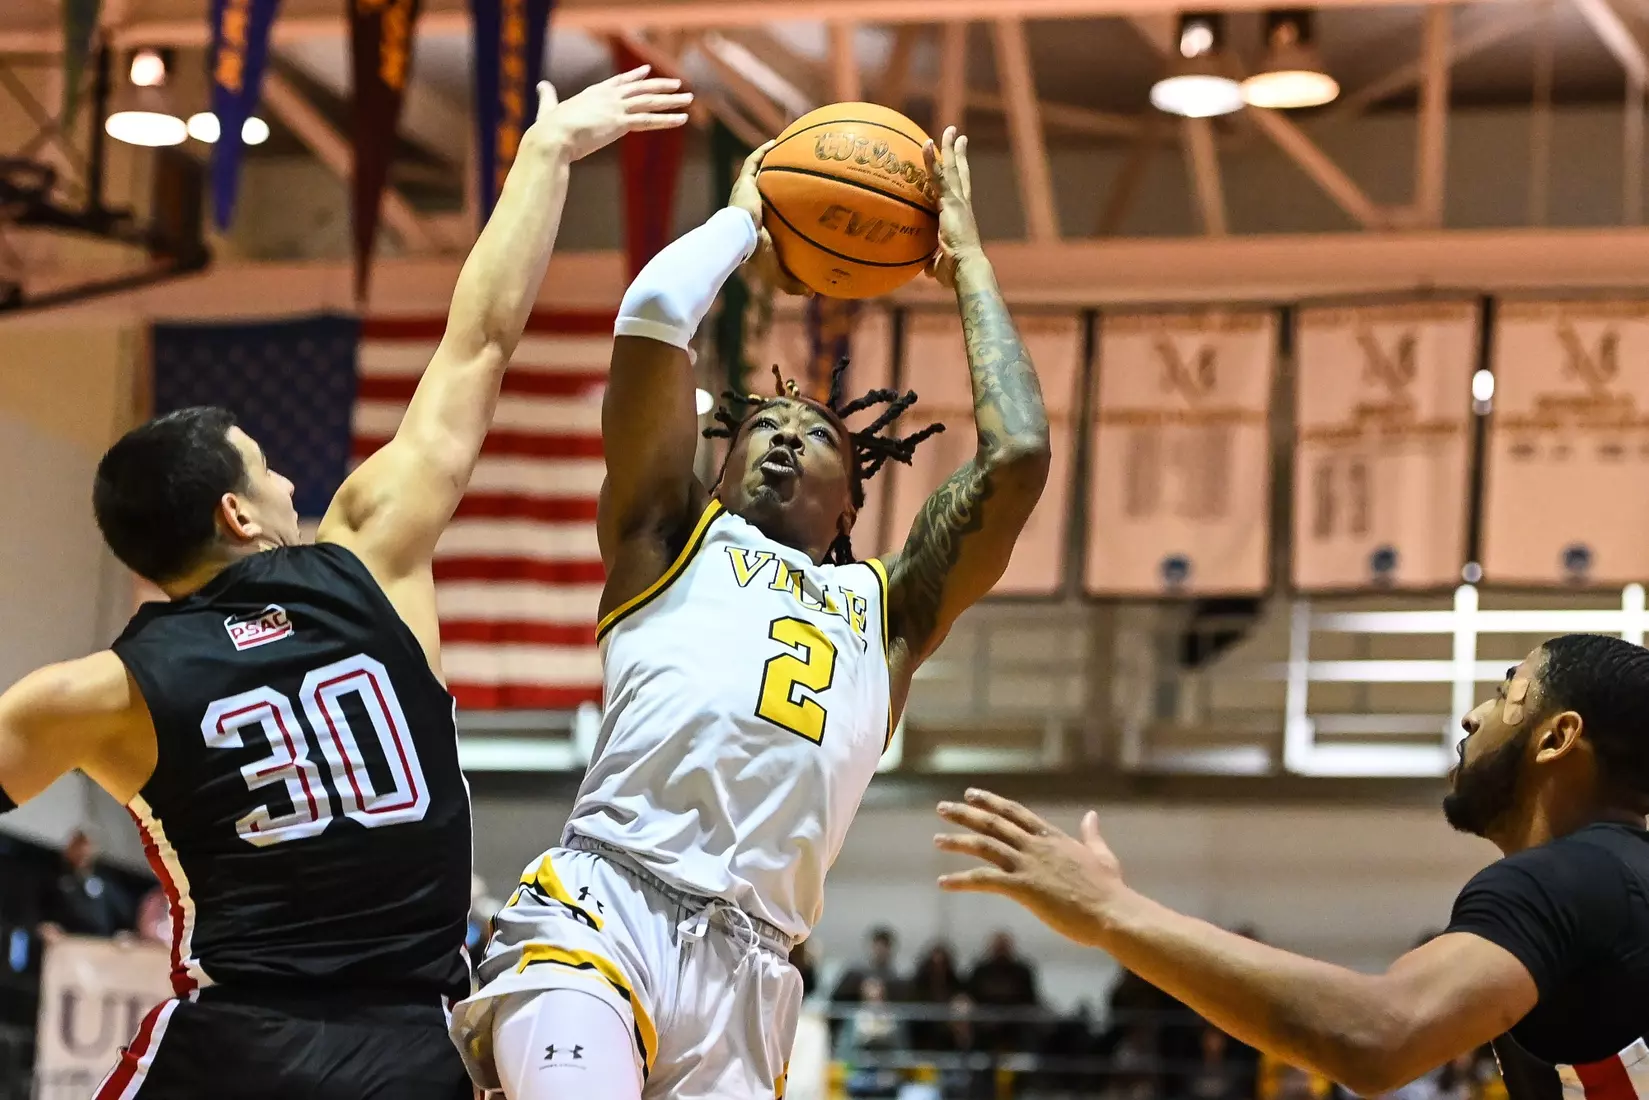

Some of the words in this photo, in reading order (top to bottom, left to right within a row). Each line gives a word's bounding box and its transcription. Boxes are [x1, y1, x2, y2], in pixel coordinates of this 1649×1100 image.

[814, 132, 935, 202] Wilson
[230, 611, 288, 640] PSAC
[724, 546, 867, 654] VILLE
[754, 615, 838, 747] 2
[200, 653, 431, 848] 30
